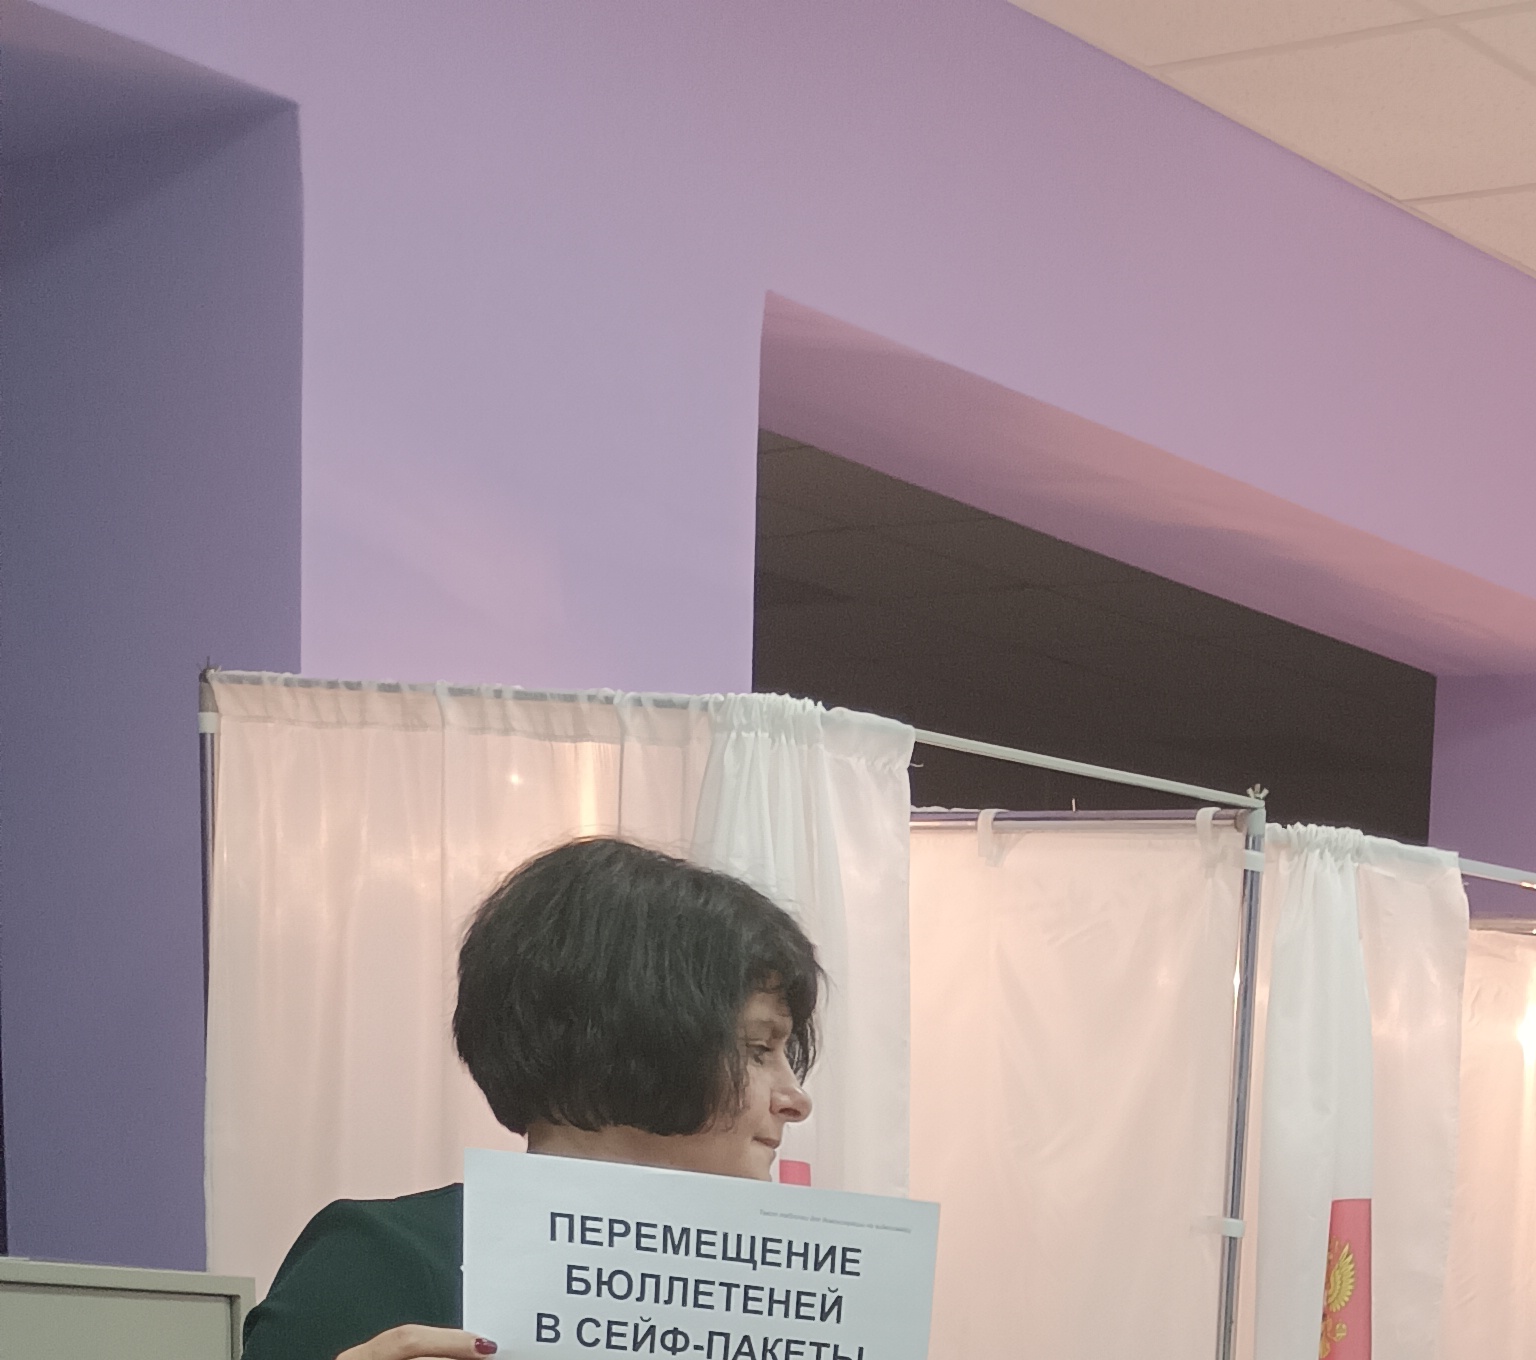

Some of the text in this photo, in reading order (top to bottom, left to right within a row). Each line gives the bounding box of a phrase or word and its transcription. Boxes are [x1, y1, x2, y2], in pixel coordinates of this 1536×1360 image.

[549, 1211, 863, 1277] ПЕРЕМЕЩЕНИЕ
[565, 1264, 844, 1325] БЮЛЛЕТЕНЕЙ
[535, 1313, 561, 1344] В
